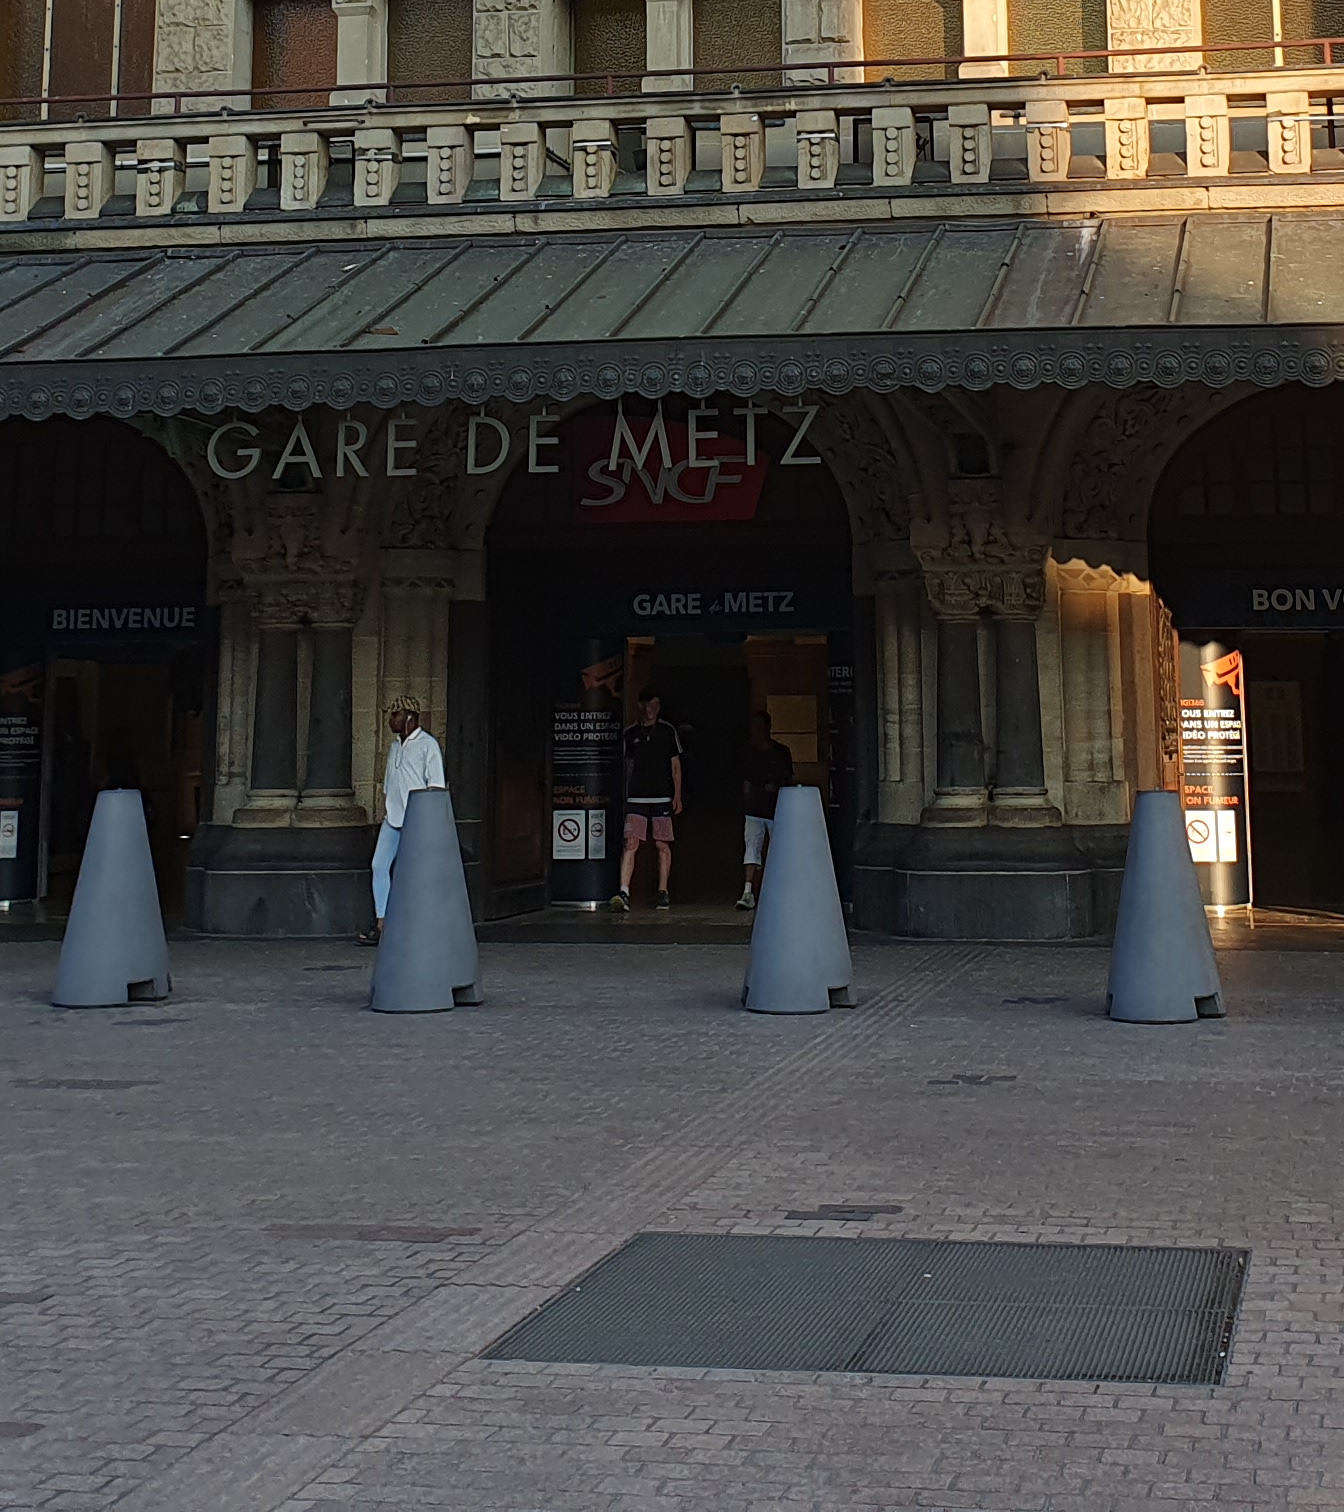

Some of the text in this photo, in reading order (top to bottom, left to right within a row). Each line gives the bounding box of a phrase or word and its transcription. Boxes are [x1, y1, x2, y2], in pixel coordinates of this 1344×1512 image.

[207, 405, 822, 479] GARE DE METZ
[580, 455, 747, 507] SNCF
[633, 593, 702, 615] GARE
[724, 591, 794, 612] METZ
[1252, 589, 1315, 611] BON
[52, 607, 195, 630] BIENVENUE
[1181, 709, 1201, 718] OUS
[580, 722, 594, 730] UN
[1181, 720, 1202, 729] ANS
[1182, 729, 1206, 739] IDÉO
[1186, 796, 1202, 805] ON
